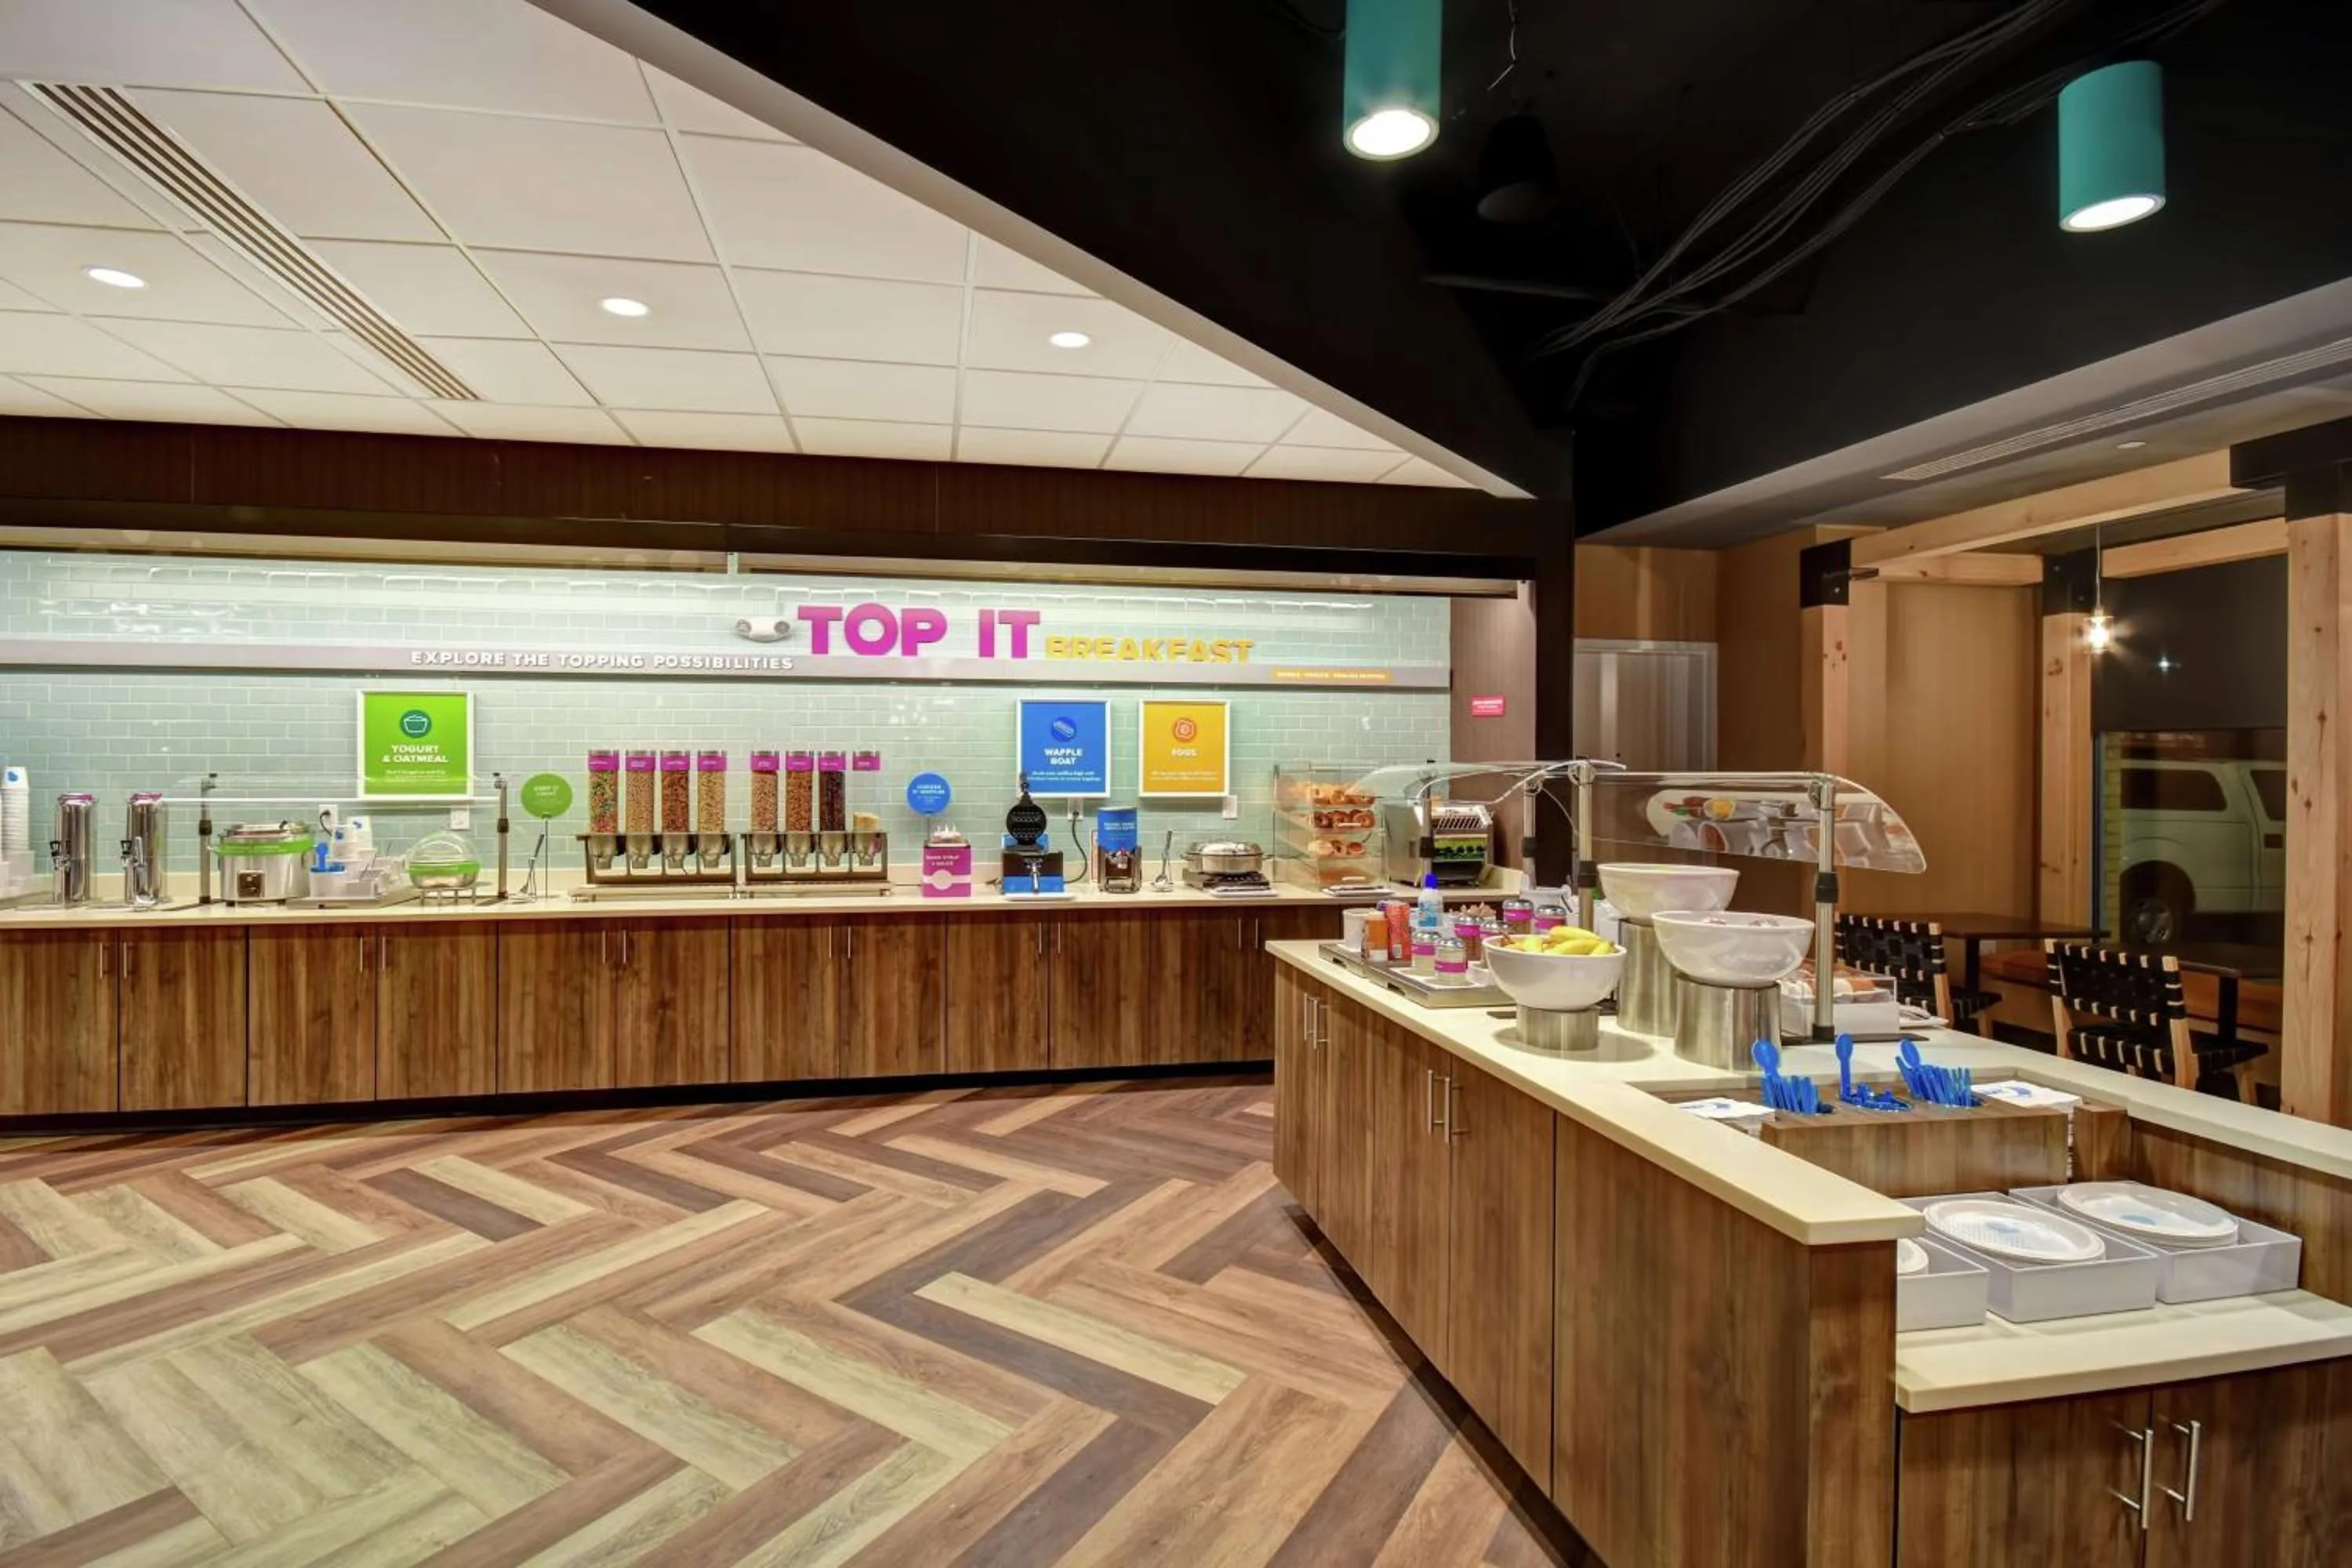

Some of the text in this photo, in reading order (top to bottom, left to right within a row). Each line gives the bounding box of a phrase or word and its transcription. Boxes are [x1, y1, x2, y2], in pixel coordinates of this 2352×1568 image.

[797, 603, 1040, 659] TOP IT
[1045, 636, 1253, 663] BREAKFAST
[412, 652, 793, 669] EXPLORE THE TOPPING POSSIBILITIES
[391, 744, 439, 753] YOGURT
[1044, 748, 1083, 757] WAFFLE
[393, 754, 448, 763] OATMEAL
[1050, 757, 1076, 765] BOAT
